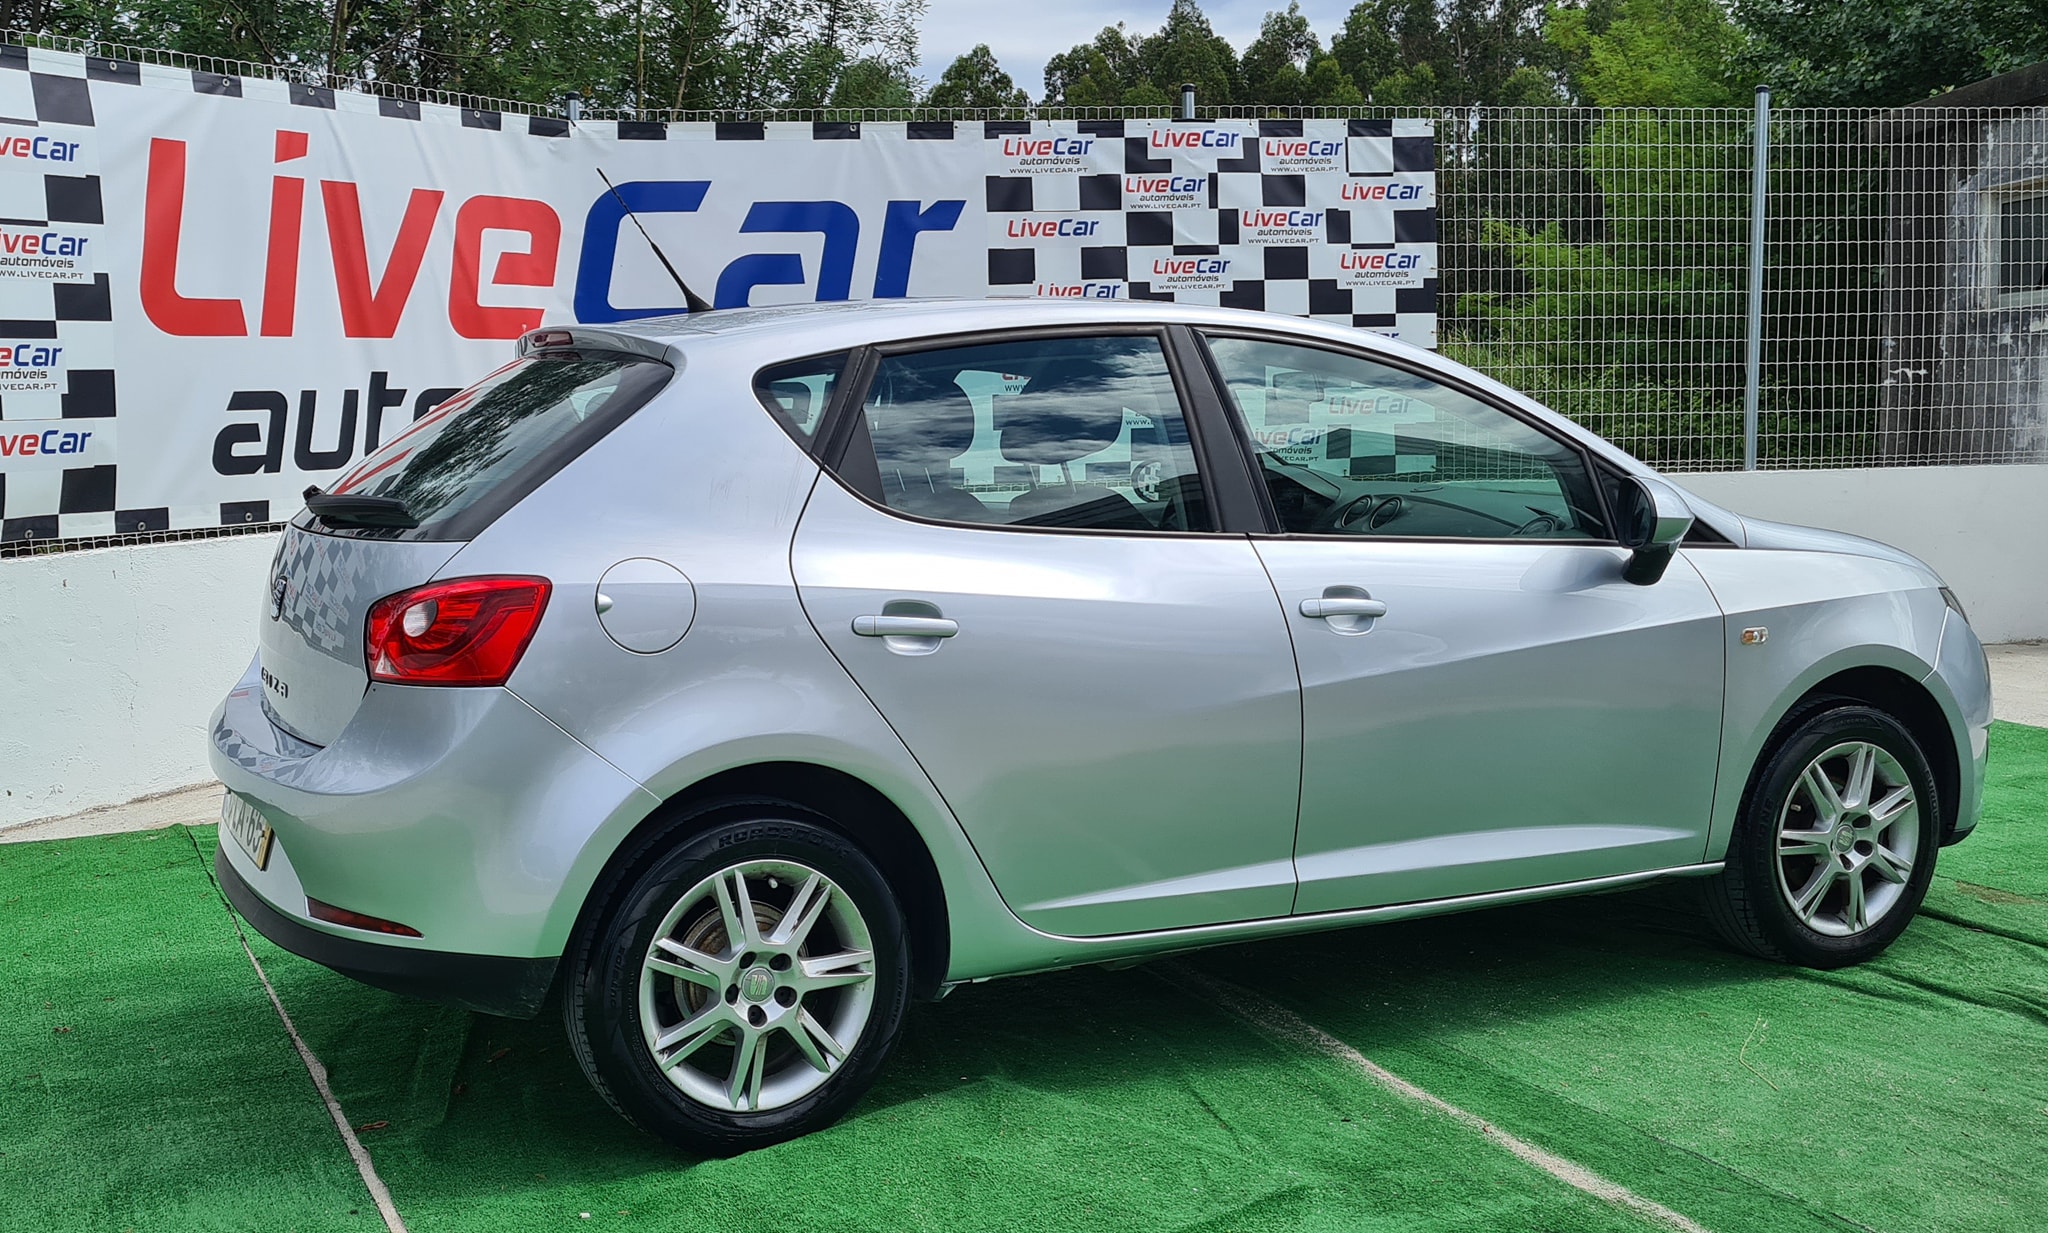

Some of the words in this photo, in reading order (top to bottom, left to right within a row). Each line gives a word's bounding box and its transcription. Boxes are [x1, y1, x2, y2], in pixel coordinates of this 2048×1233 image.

[1003, 137, 1094, 156] LiveCar
[1152, 129, 1239, 147] LiveCar
[1265, 140, 1343, 156] LiveCar
[1019, 156, 1080, 166] automóveis
[1279, 157, 1332, 165] automóveis
[1125, 176, 1206, 193] LiveCar
[1341, 182, 1424, 200] LiveCar
[1139, 193, 1195, 202] automóveis
[1242, 209, 1324, 227] LiveCar
[140, 129, 967, 338] LiveCar
[1007, 218, 1099, 237] LiveCar
[1257, 228, 1313, 237] automóveis
[1153, 258, 1231, 274] LiveCar
[1340, 252, 1421, 270] LiveCar
[1167, 274, 1219, 283] automóveis
[1354, 270, 1409, 279] automóveis
[1329, 396, 1413, 415] LiveCar
[212, 371, 465, 475] aut
